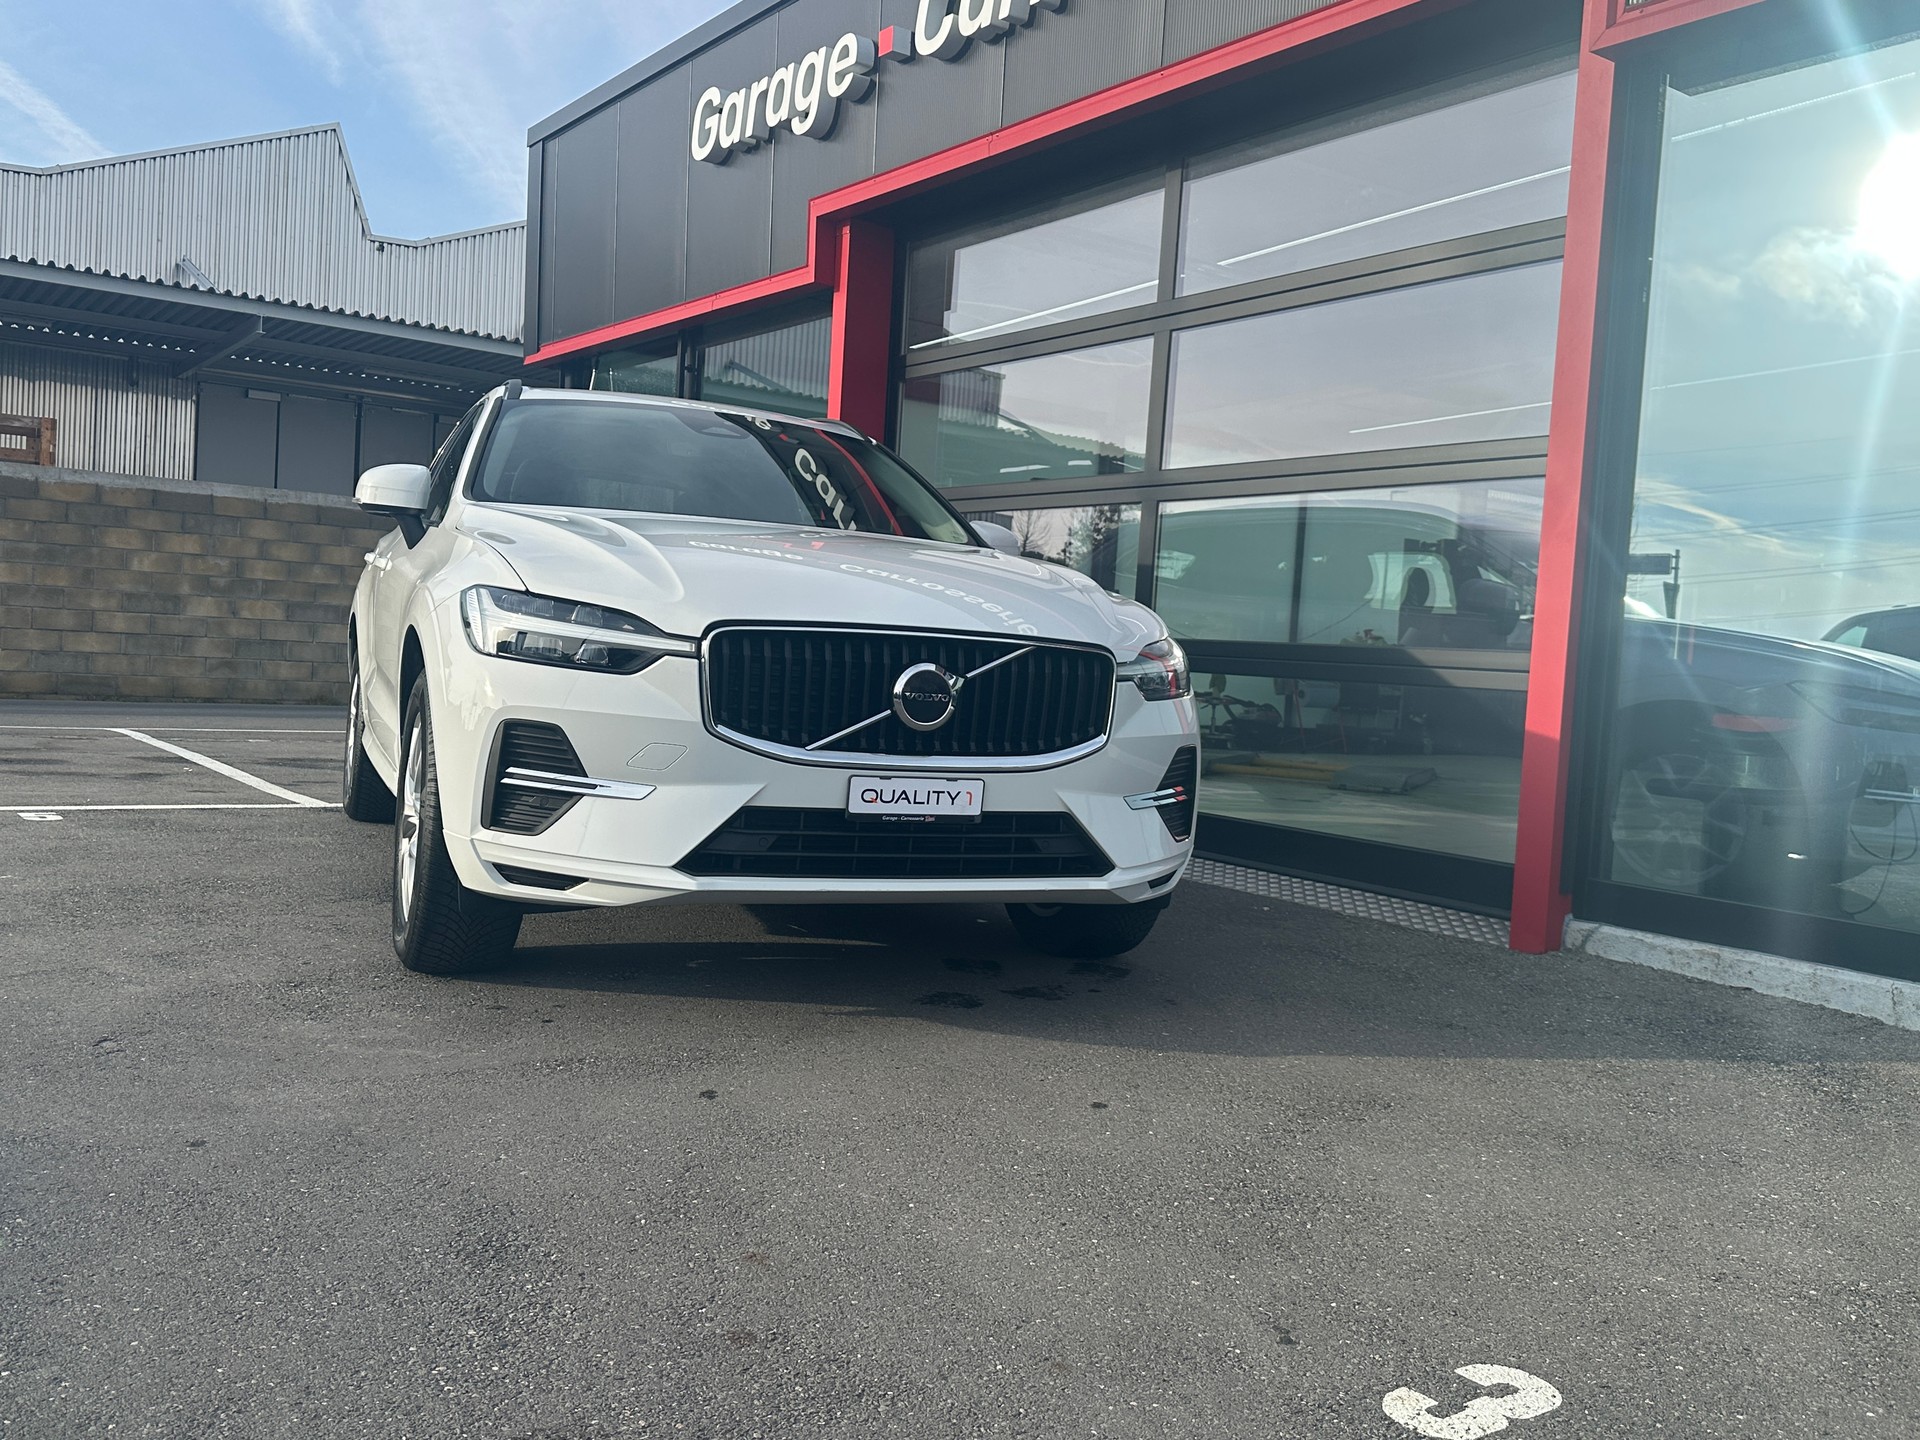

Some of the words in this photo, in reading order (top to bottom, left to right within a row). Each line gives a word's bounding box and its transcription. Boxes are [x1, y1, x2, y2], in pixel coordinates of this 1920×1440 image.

[691, 32, 859, 162] Garage
[904, 692, 950, 702] VOLVO
[861, 788, 962, 806] QUALITY
[965, 791, 973, 806] 1
[1381, 1363, 1563, 1440] 3
